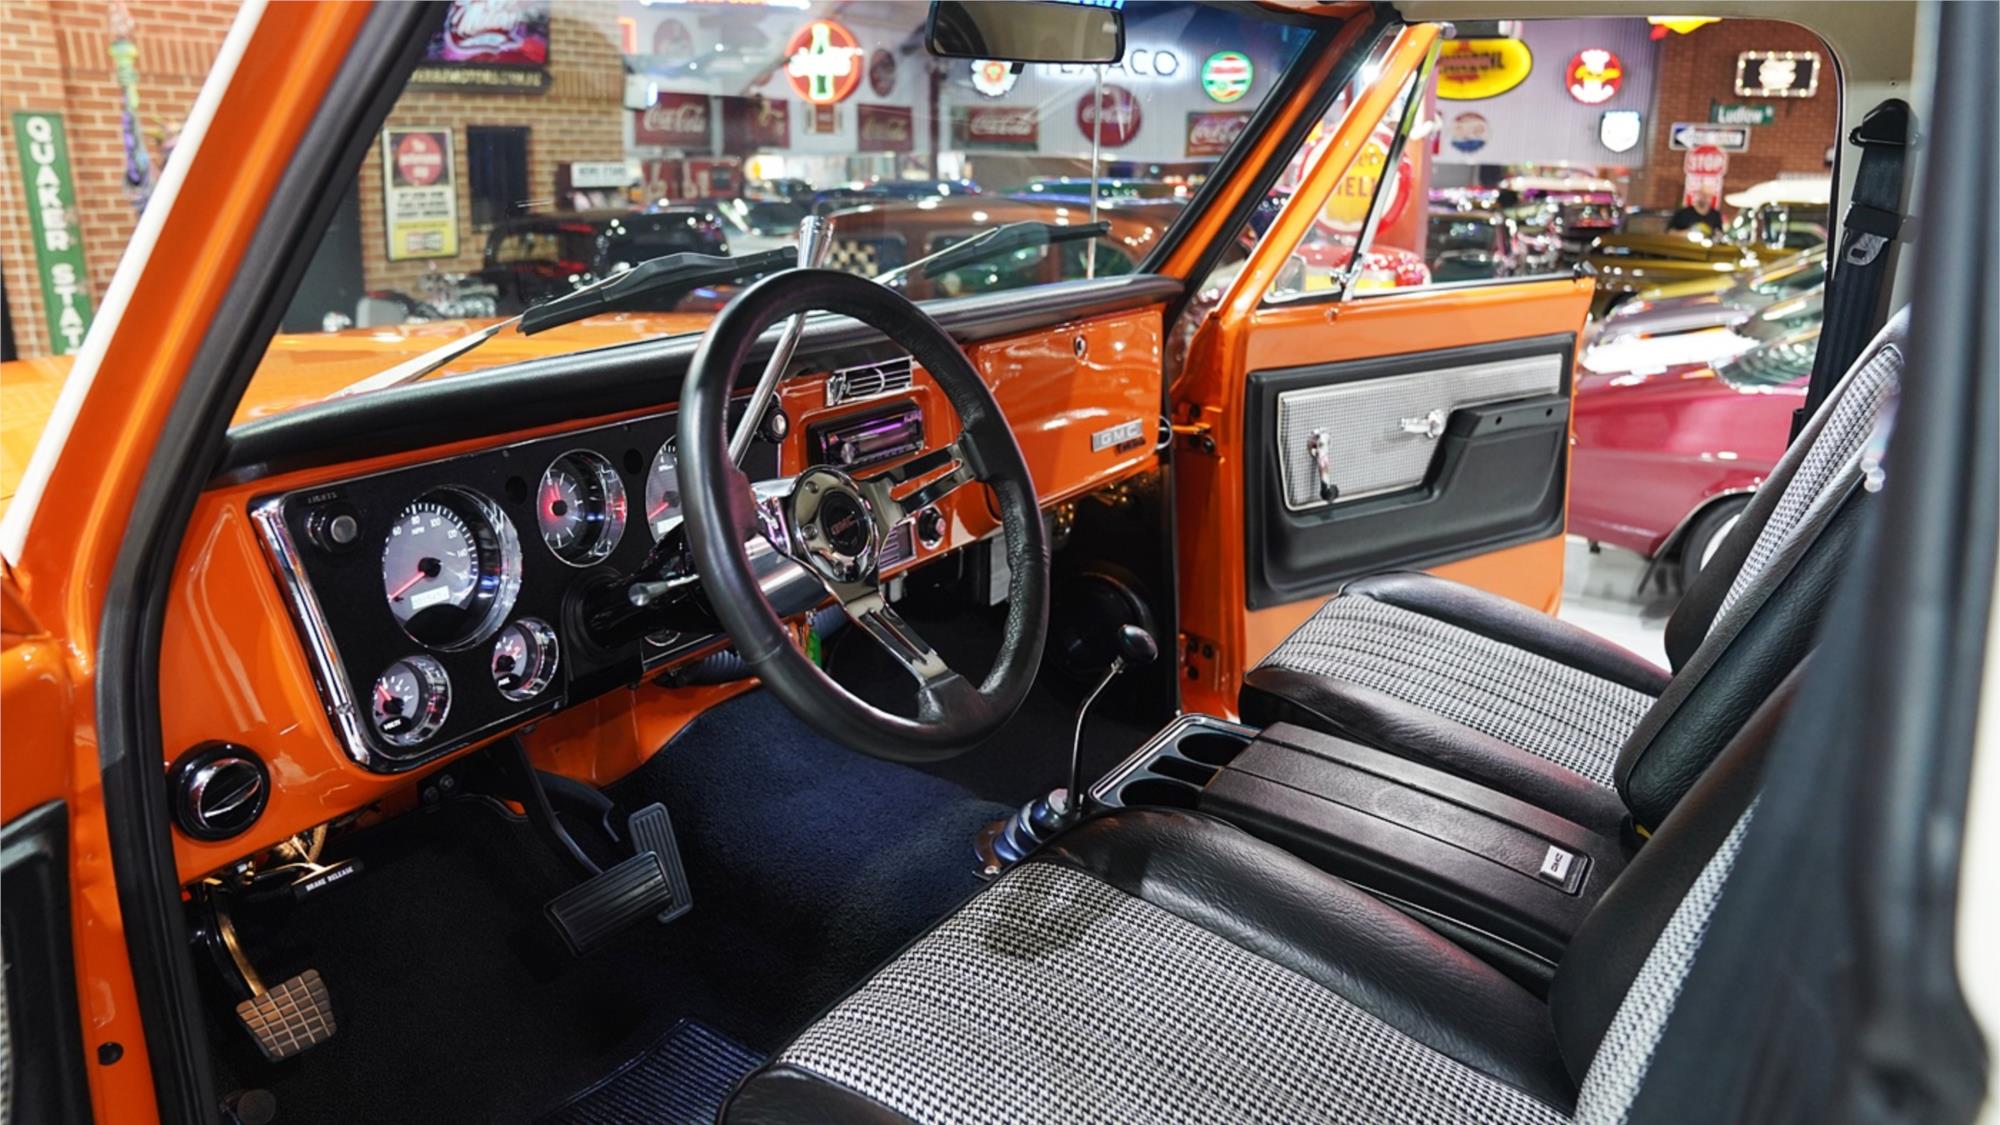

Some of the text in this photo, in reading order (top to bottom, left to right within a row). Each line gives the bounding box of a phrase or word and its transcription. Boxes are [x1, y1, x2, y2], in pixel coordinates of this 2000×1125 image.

[1688, 154, 1723, 171] STOP
[26, 116, 84, 354] QUAKER STAT
[1100, 421, 1140, 446] GMC
[831, 514, 856, 536] GMC
